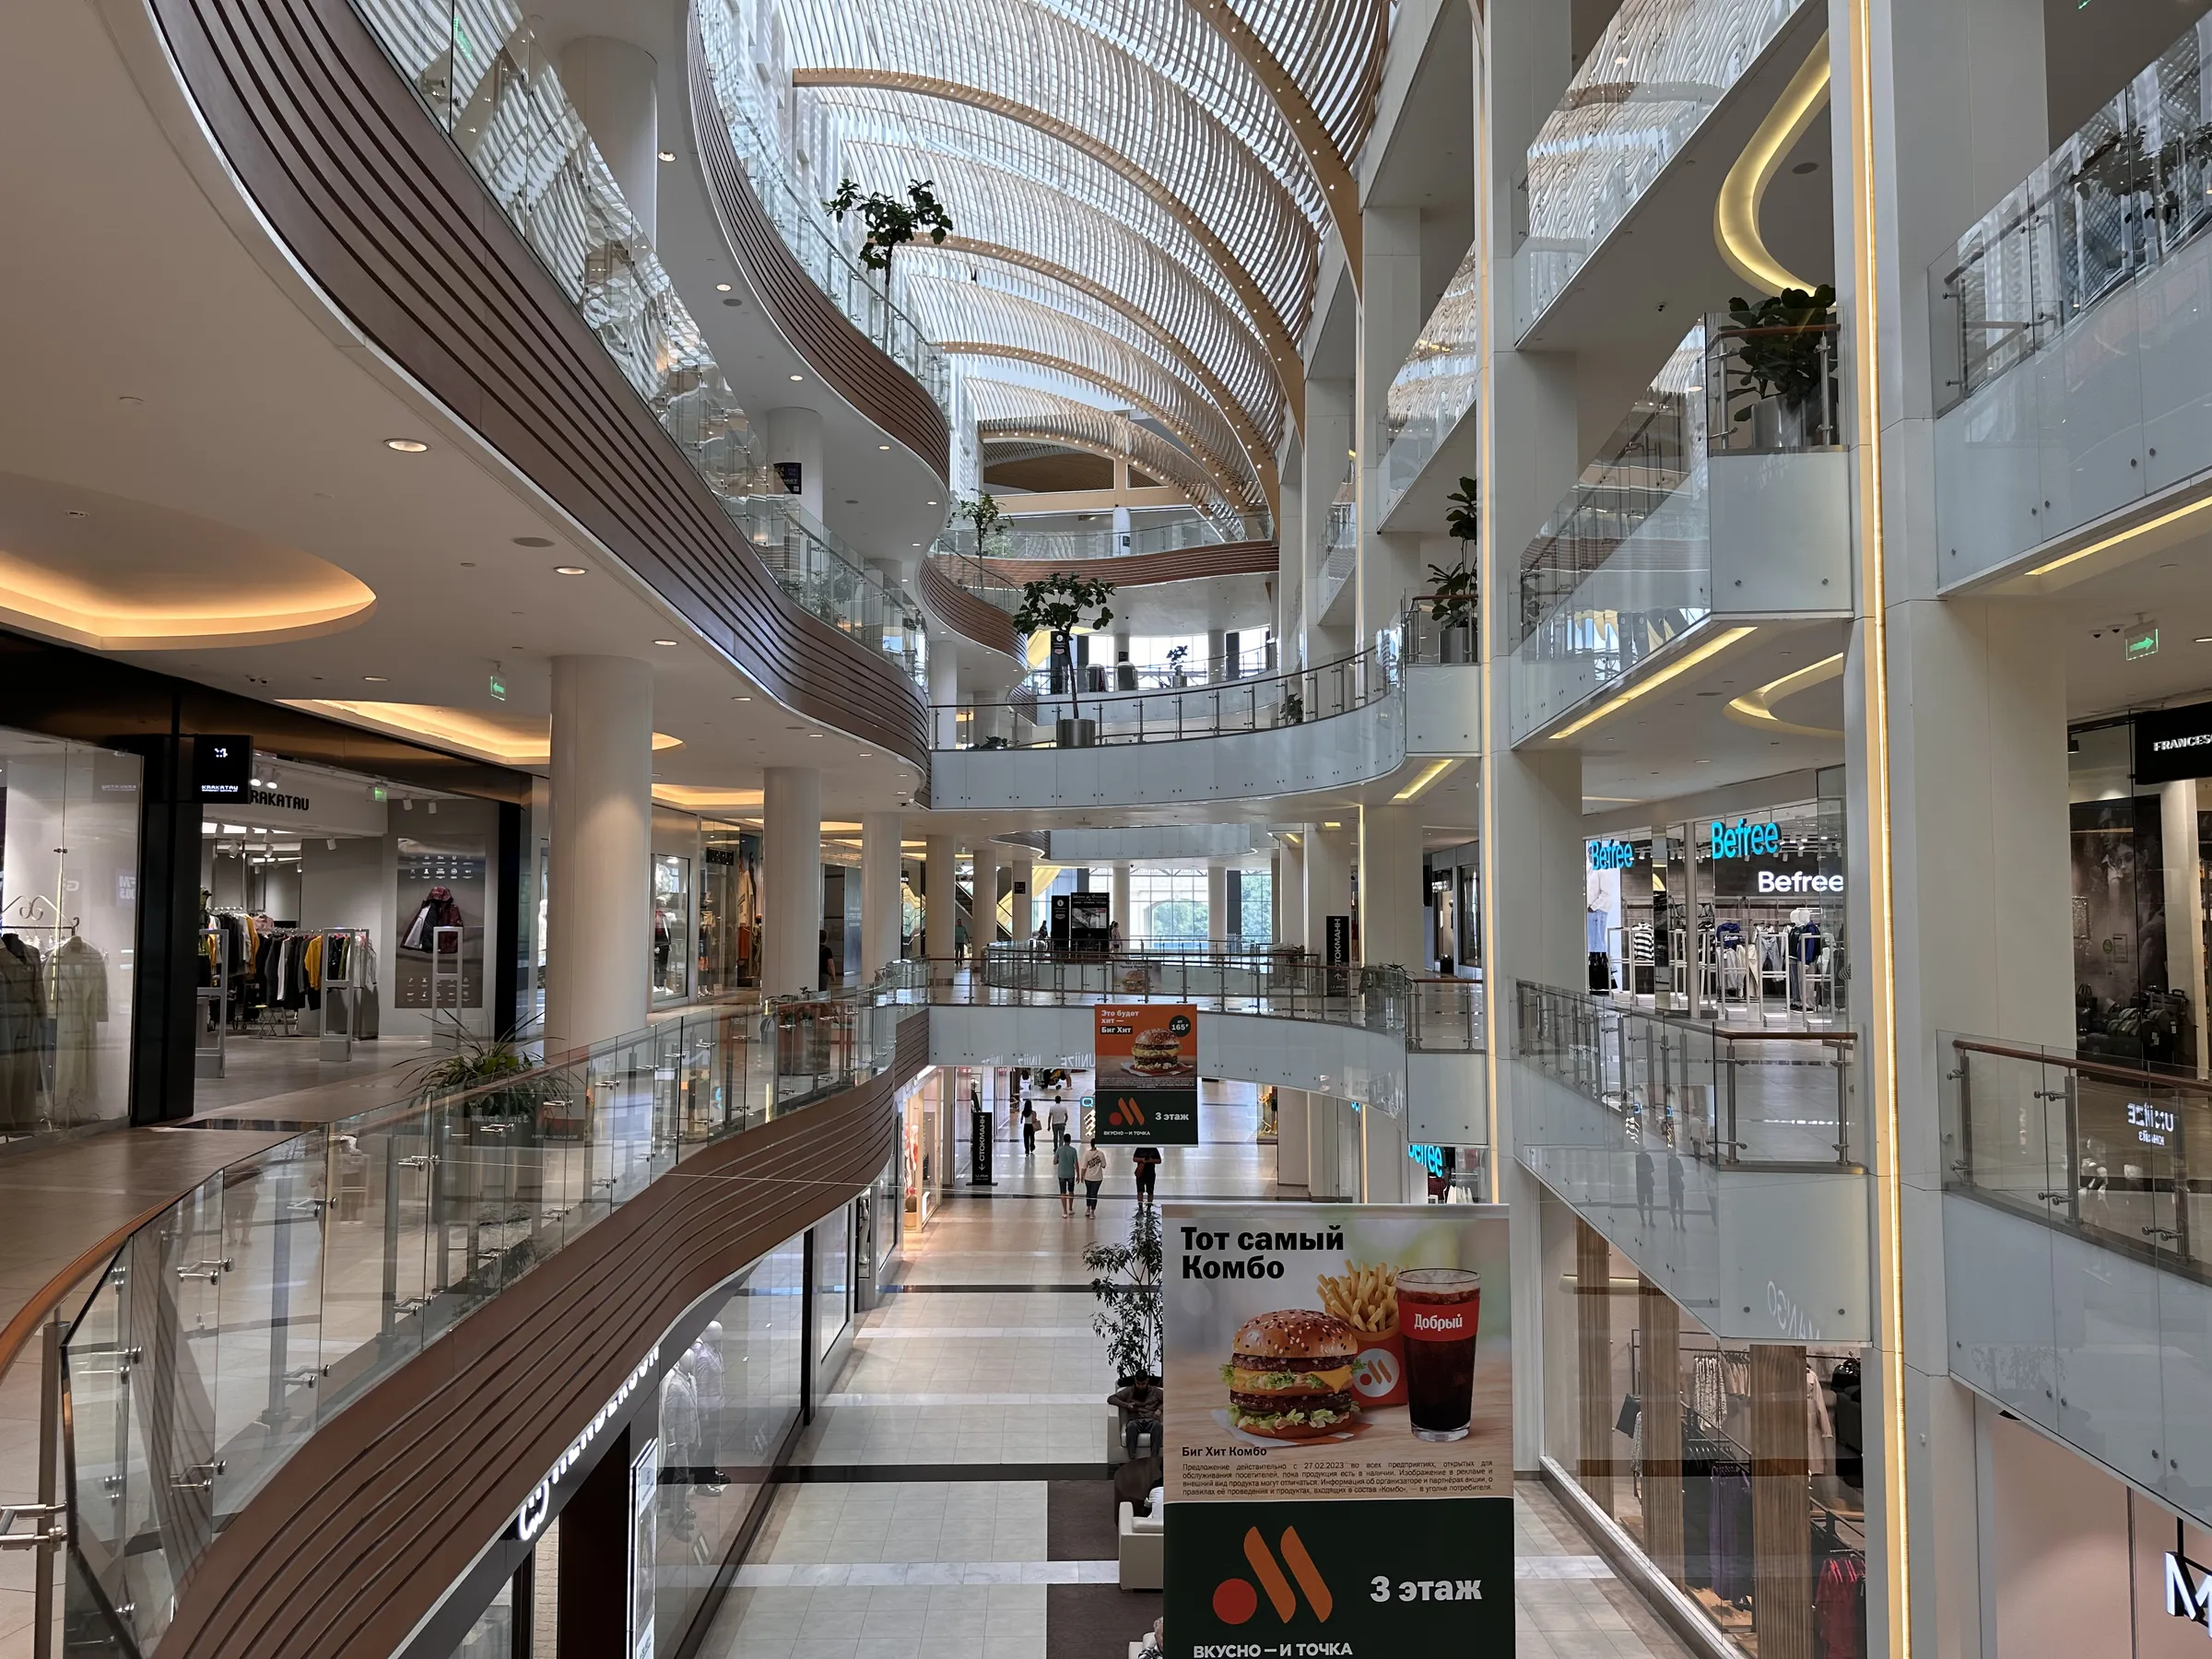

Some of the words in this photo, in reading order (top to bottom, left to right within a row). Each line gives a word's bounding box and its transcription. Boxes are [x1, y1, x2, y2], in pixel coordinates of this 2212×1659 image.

[2153, 734, 2212, 751] FRANCES
[1711, 818, 1782, 860] Befree
[1591, 840, 1635, 870] Befree
[1759, 871, 1843, 892] Befree
[1155, 1112, 1162, 1121] 3
[1163, 1112, 1189, 1121] этаж
[1181, 1227, 1230, 1251] Тот
[1238, 1225, 1344, 1251] самый
[1182, 1254, 1285, 1279] Комбо
[1414, 1313, 1463, 1332] Добрый
[1182, 1446, 1203, 1457] Биг
[1206, 1446, 1227, 1456] Хит
[1230, 1445, 1267, 1456] Комбо
[1182, 1464, 1230, 1472] Предложение
[1236, 1463, 1287, 1471] действительно
[1370, 1575, 1391, 1603] 3
[1398, 1579, 1482, 1602] этаж
[1194, 1644, 1262, 1659] ВКУСНО
[1279, 1643, 1291, 1656] И
[1296, 1642, 1353, 1656] ТОЧКА
